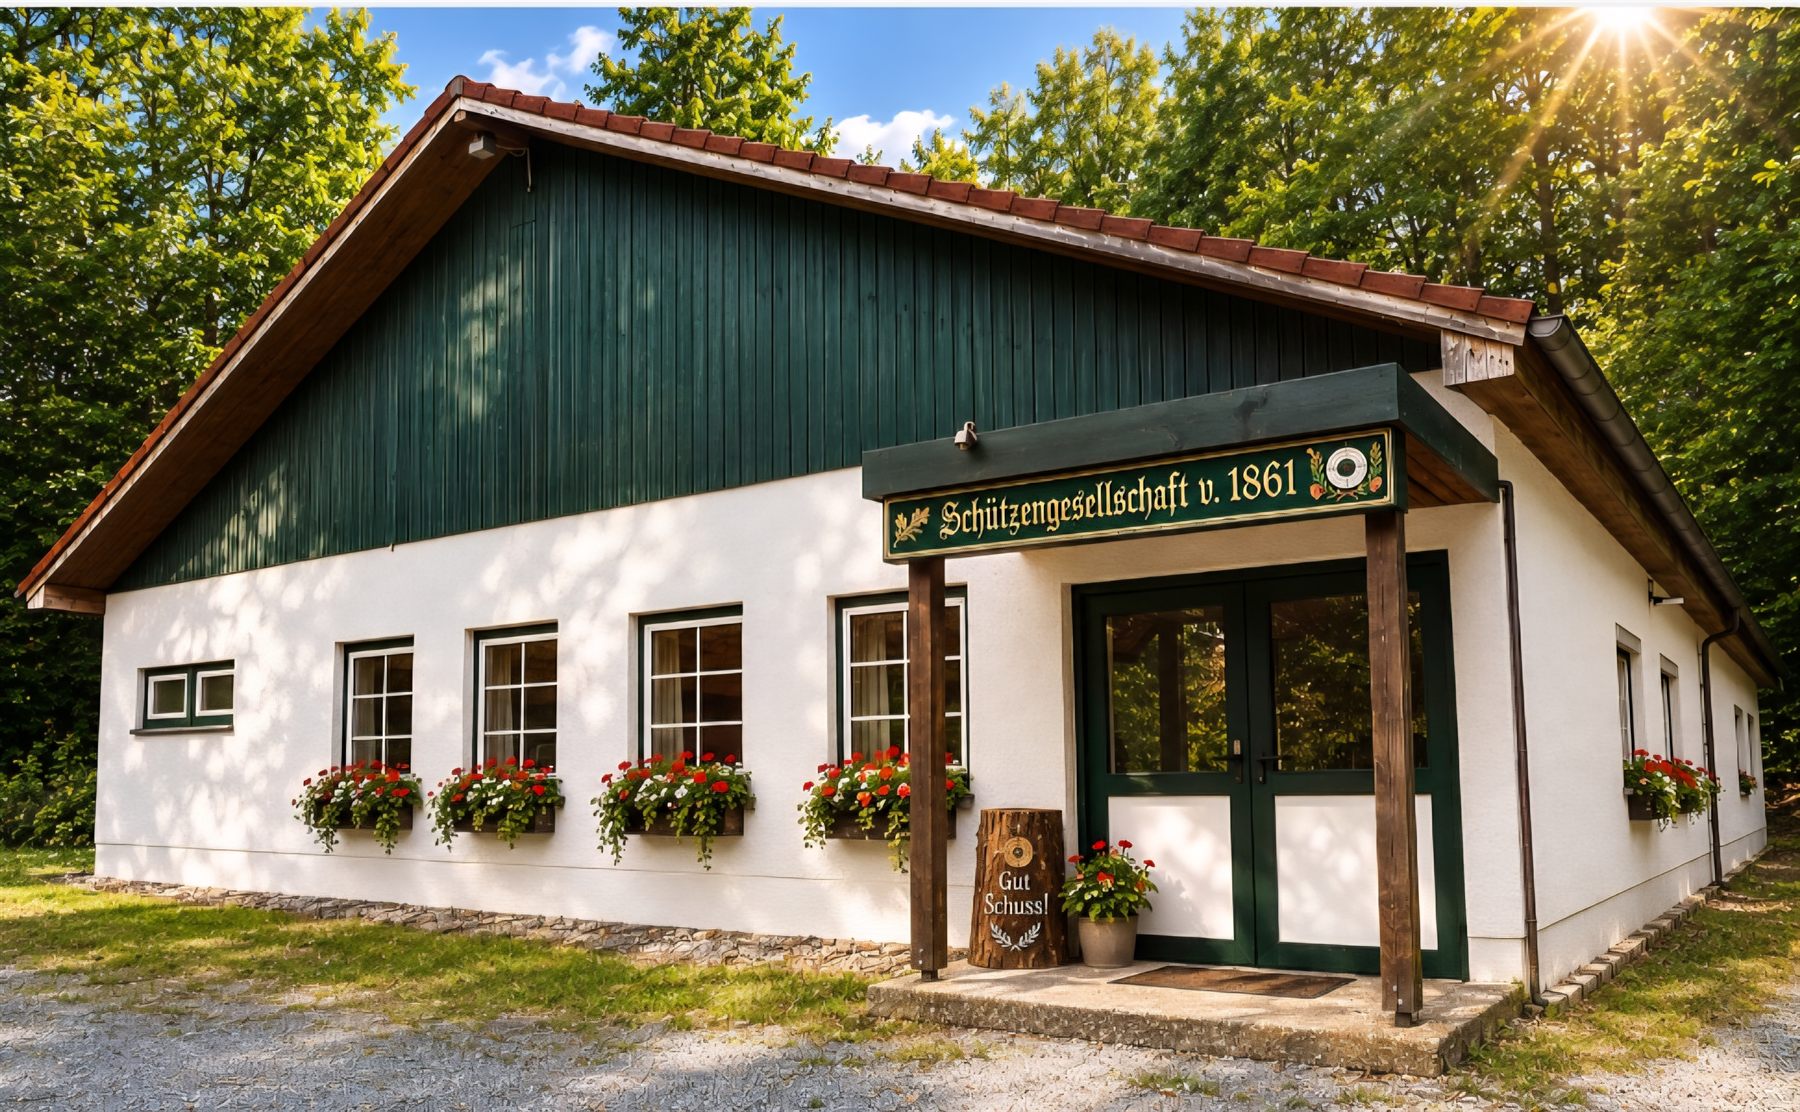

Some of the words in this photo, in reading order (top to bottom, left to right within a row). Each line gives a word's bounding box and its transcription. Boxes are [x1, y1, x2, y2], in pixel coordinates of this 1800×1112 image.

[939, 470, 1188, 541] Schützengesellschaft
[1198, 478, 1221, 505] v.
[1228, 459, 1298, 502] 1861
[999, 871, 1030, 890] Gut
